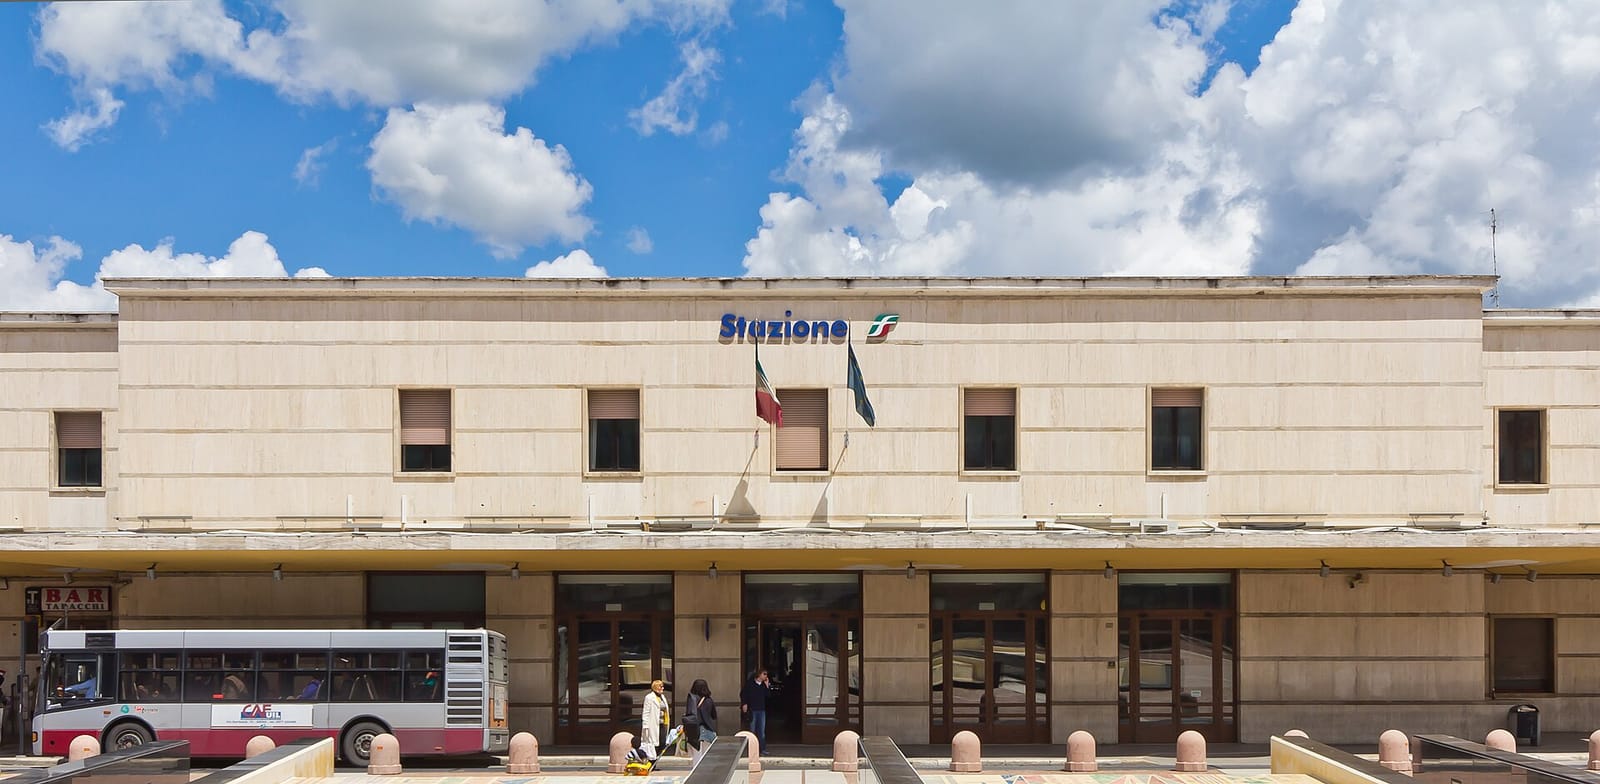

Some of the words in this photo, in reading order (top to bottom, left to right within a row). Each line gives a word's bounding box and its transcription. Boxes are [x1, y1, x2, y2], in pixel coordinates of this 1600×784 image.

[719, 310, 848, 338] Stazione
[46, 589, 104, 602] BAR
[242, 704, 272, 718] CAF
